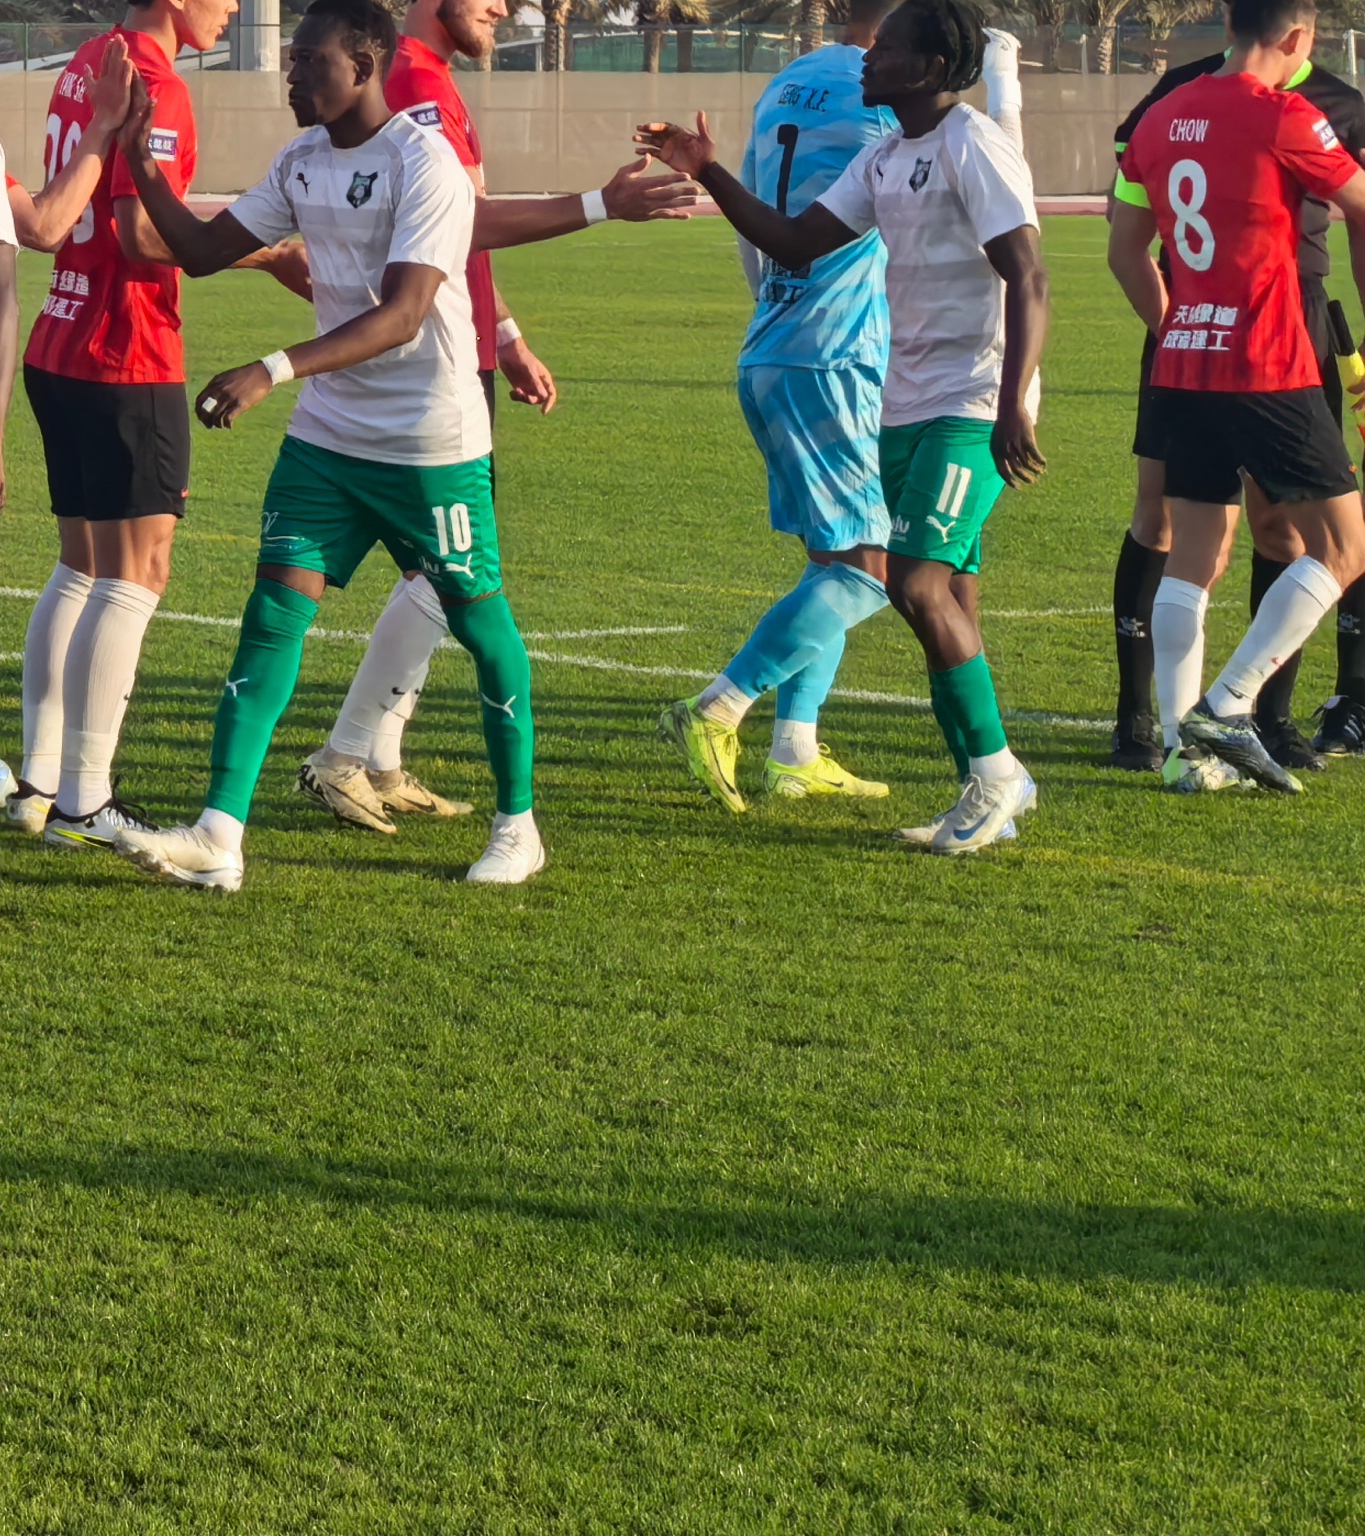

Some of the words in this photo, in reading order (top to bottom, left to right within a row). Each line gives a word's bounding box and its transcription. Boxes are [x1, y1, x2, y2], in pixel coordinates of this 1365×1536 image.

[1169, 118, 1209, 143] CHOW
[1167, 158, 1216, 272] 8
[935, 461, 972, 518] 11
[431, 502, 473, 557] 10
